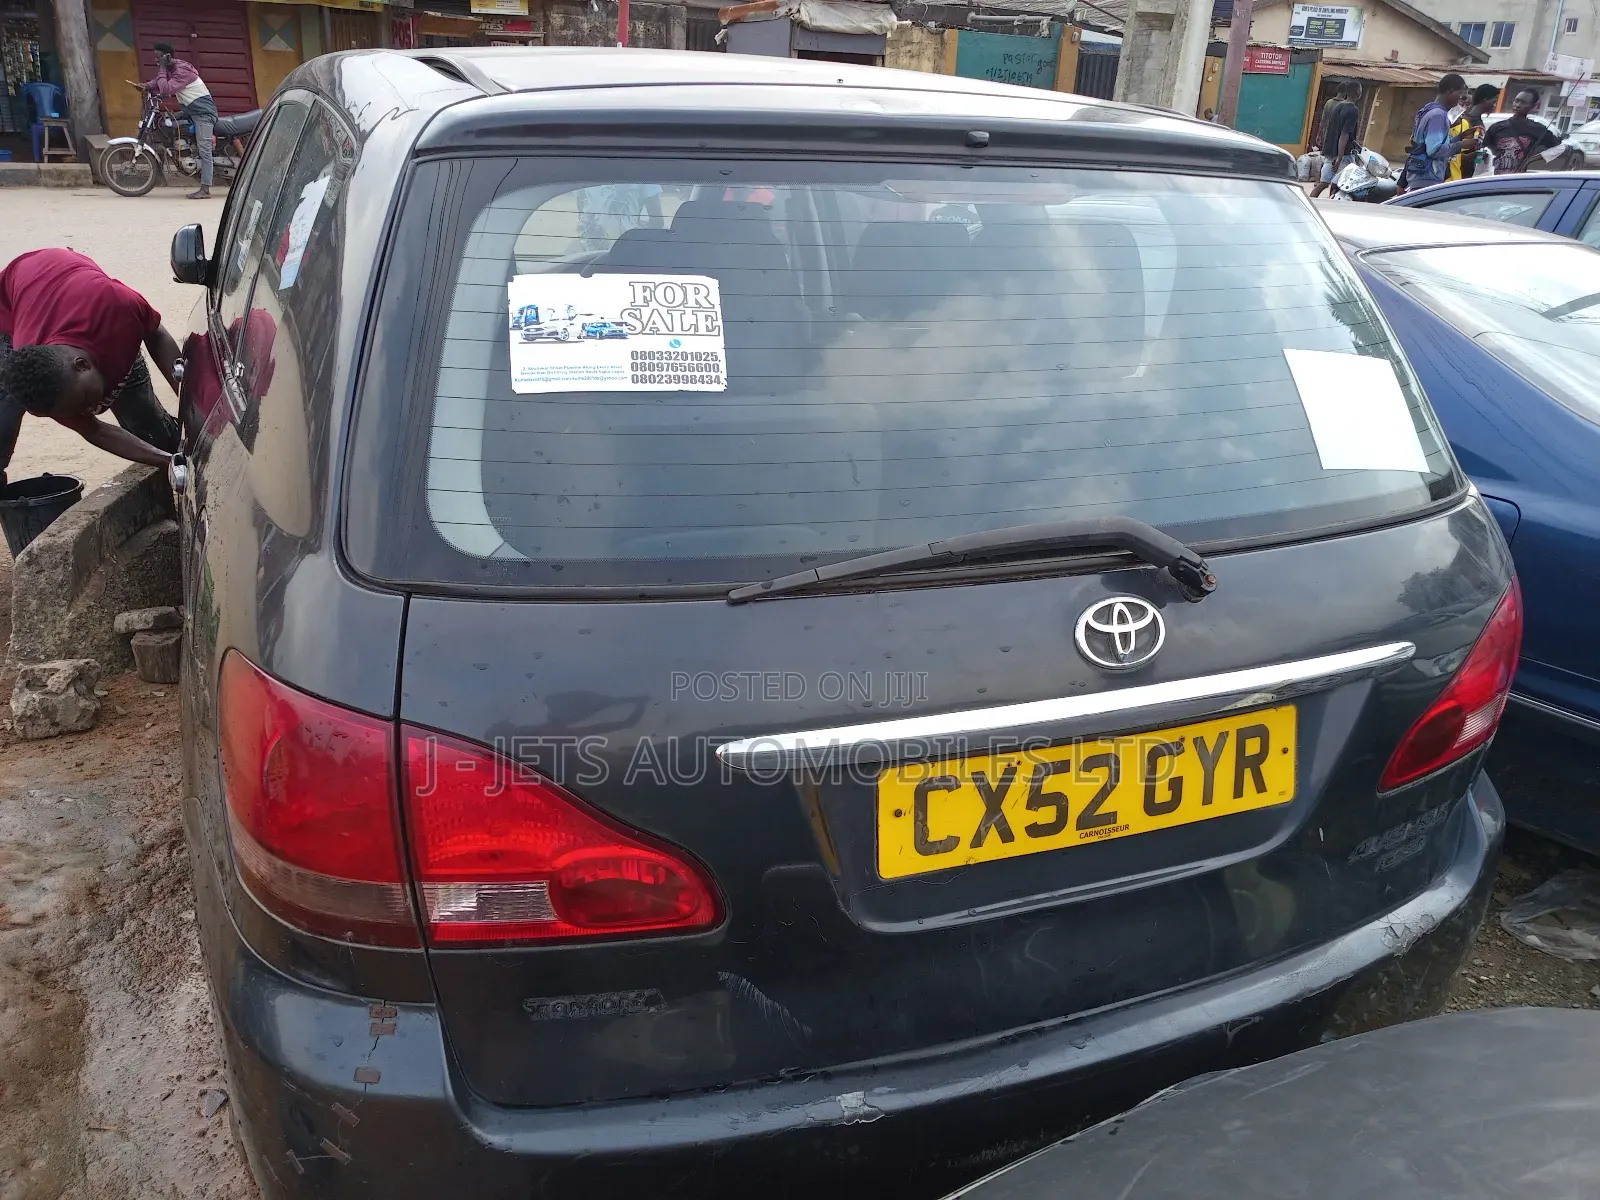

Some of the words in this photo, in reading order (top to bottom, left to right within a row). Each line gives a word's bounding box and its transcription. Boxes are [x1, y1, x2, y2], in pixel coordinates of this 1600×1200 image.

[628, 281, 715, 309] FOR
[620, 308, 720, 337] SALE
[912, 752, 1121, 858] CX52
[1142, 723, 1271, 817] GYR
[1079, 823, 1130, 840] CARNOISSEUR
